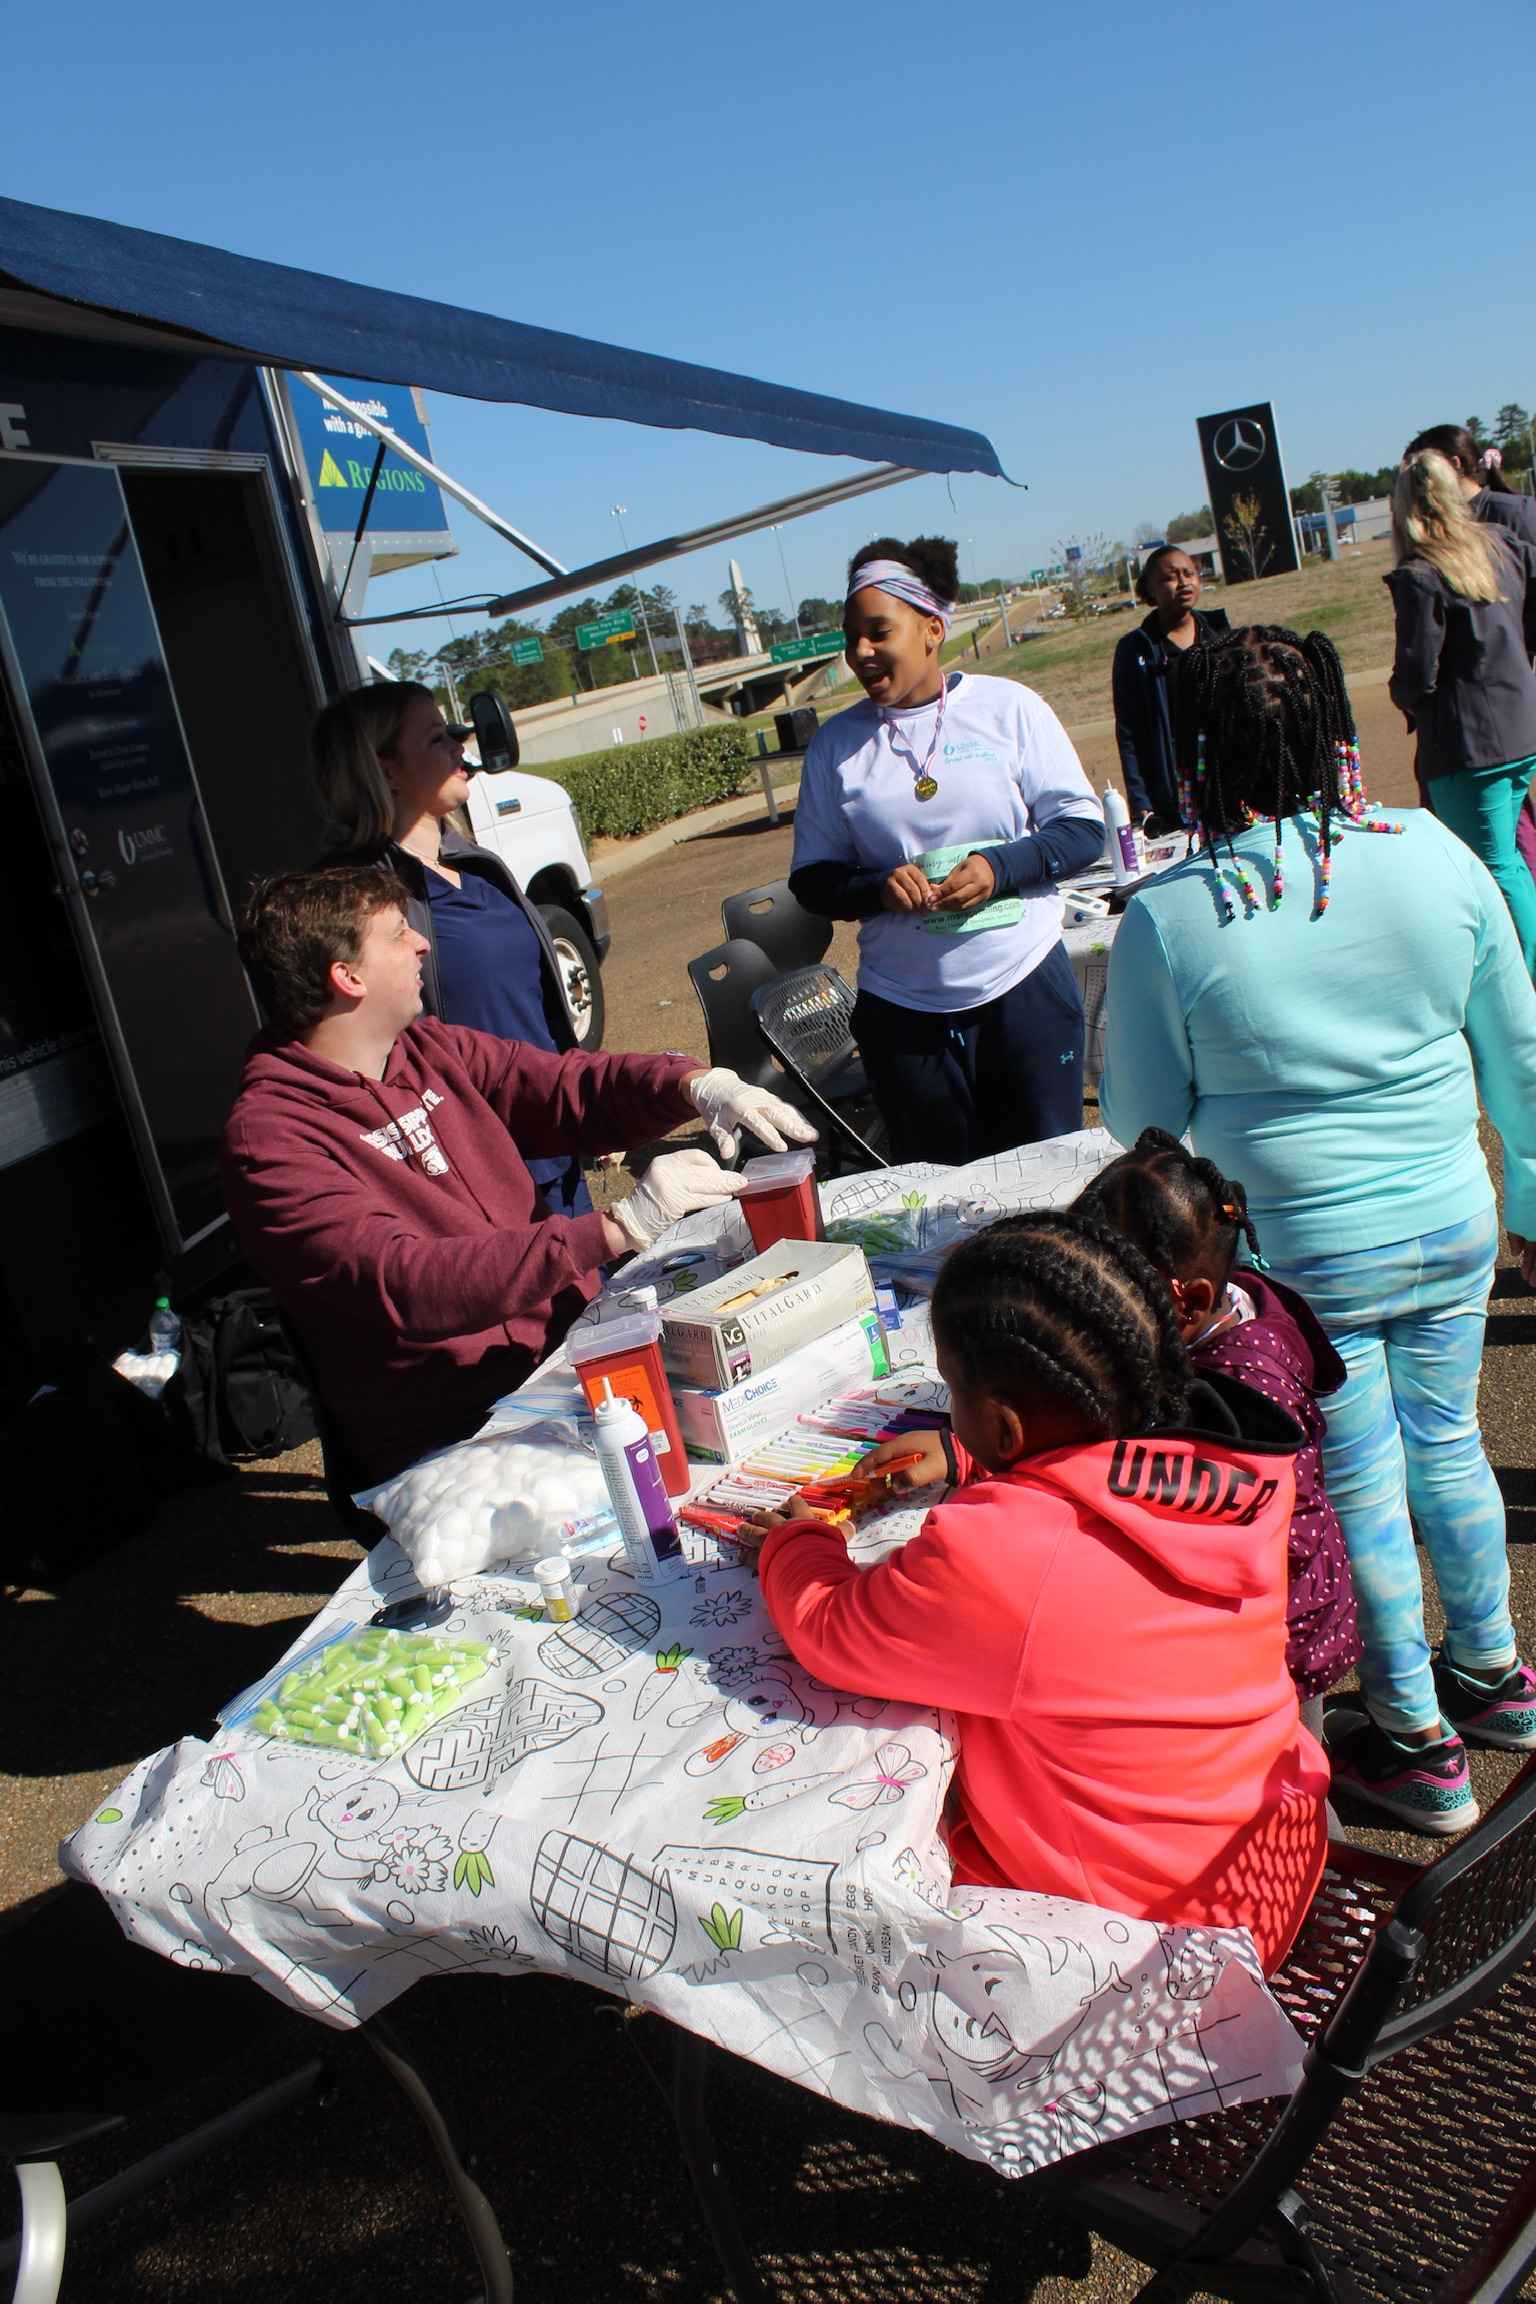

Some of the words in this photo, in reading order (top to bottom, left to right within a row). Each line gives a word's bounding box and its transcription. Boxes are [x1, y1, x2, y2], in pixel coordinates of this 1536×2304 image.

[742, 1282, 824, 1330] VITALGARD
[723, 1326, 744, 1345] VG
[1107, 1439, 1279, 1527] UNDER
[846, 1883, 857, 1909] EGG
[863, 1887, 873, 1911] HOP
